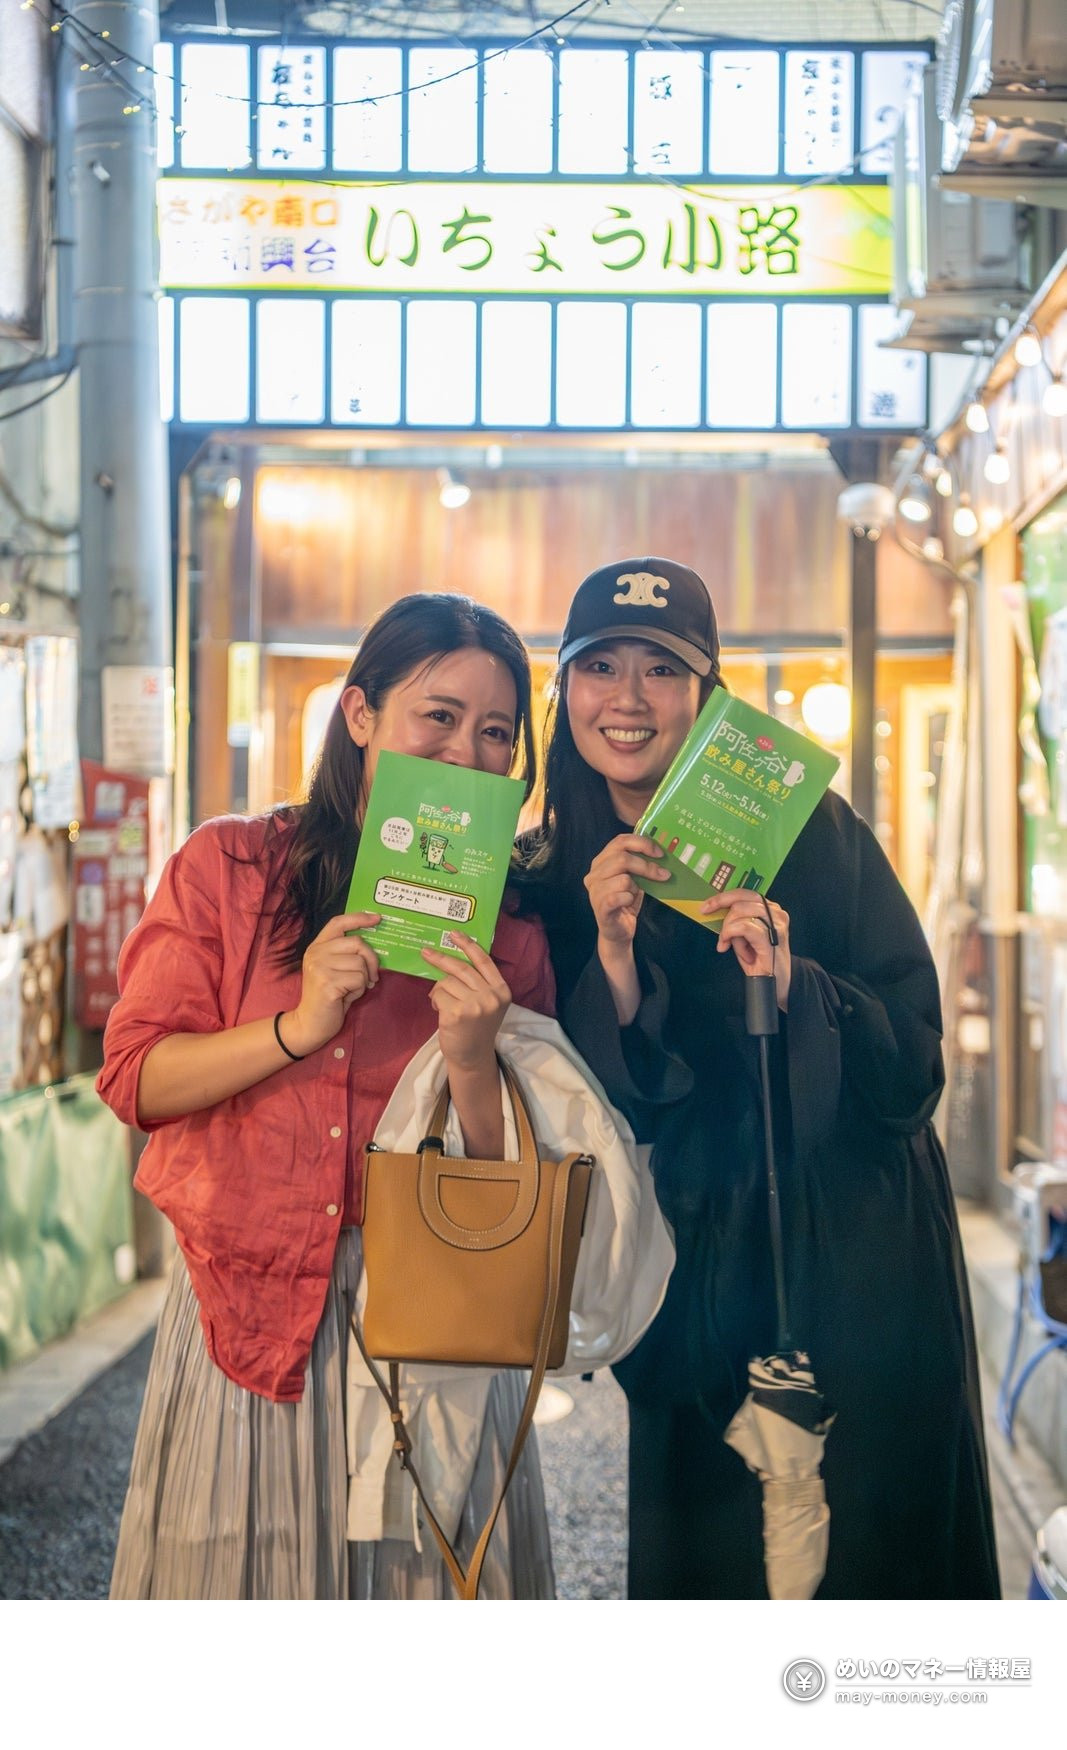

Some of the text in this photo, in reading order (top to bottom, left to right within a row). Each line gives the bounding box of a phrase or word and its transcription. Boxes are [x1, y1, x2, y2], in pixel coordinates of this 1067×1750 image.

[365, 203, 800, 275] いちょう小路
[703, 744, 792, 800] 飲み屋さん祭り
[712, 719, 788, 773] 阿佐ヶ谷
[382, 890, 420, 905] アンケート
